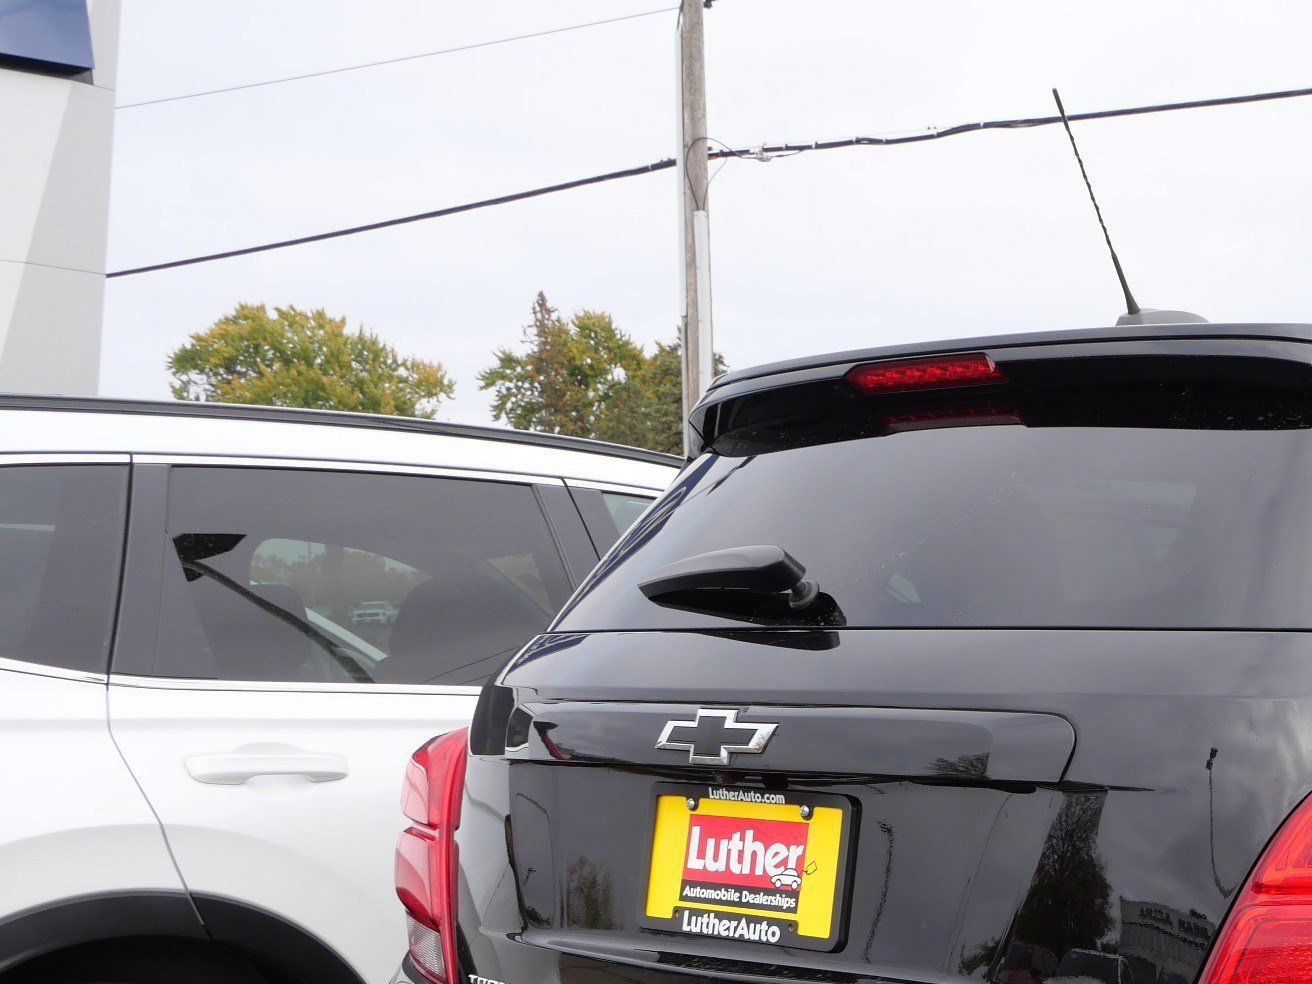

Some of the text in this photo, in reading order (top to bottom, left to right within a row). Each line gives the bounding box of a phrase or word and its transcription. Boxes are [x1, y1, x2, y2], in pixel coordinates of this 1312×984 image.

[708, 787, 785, 804] LutherAuto.com
[686, 825, 804, 878] Luther
[682, 885, 796, 909] Automobile Dealerships
[682, 910, 781, 943] LutherAuto
